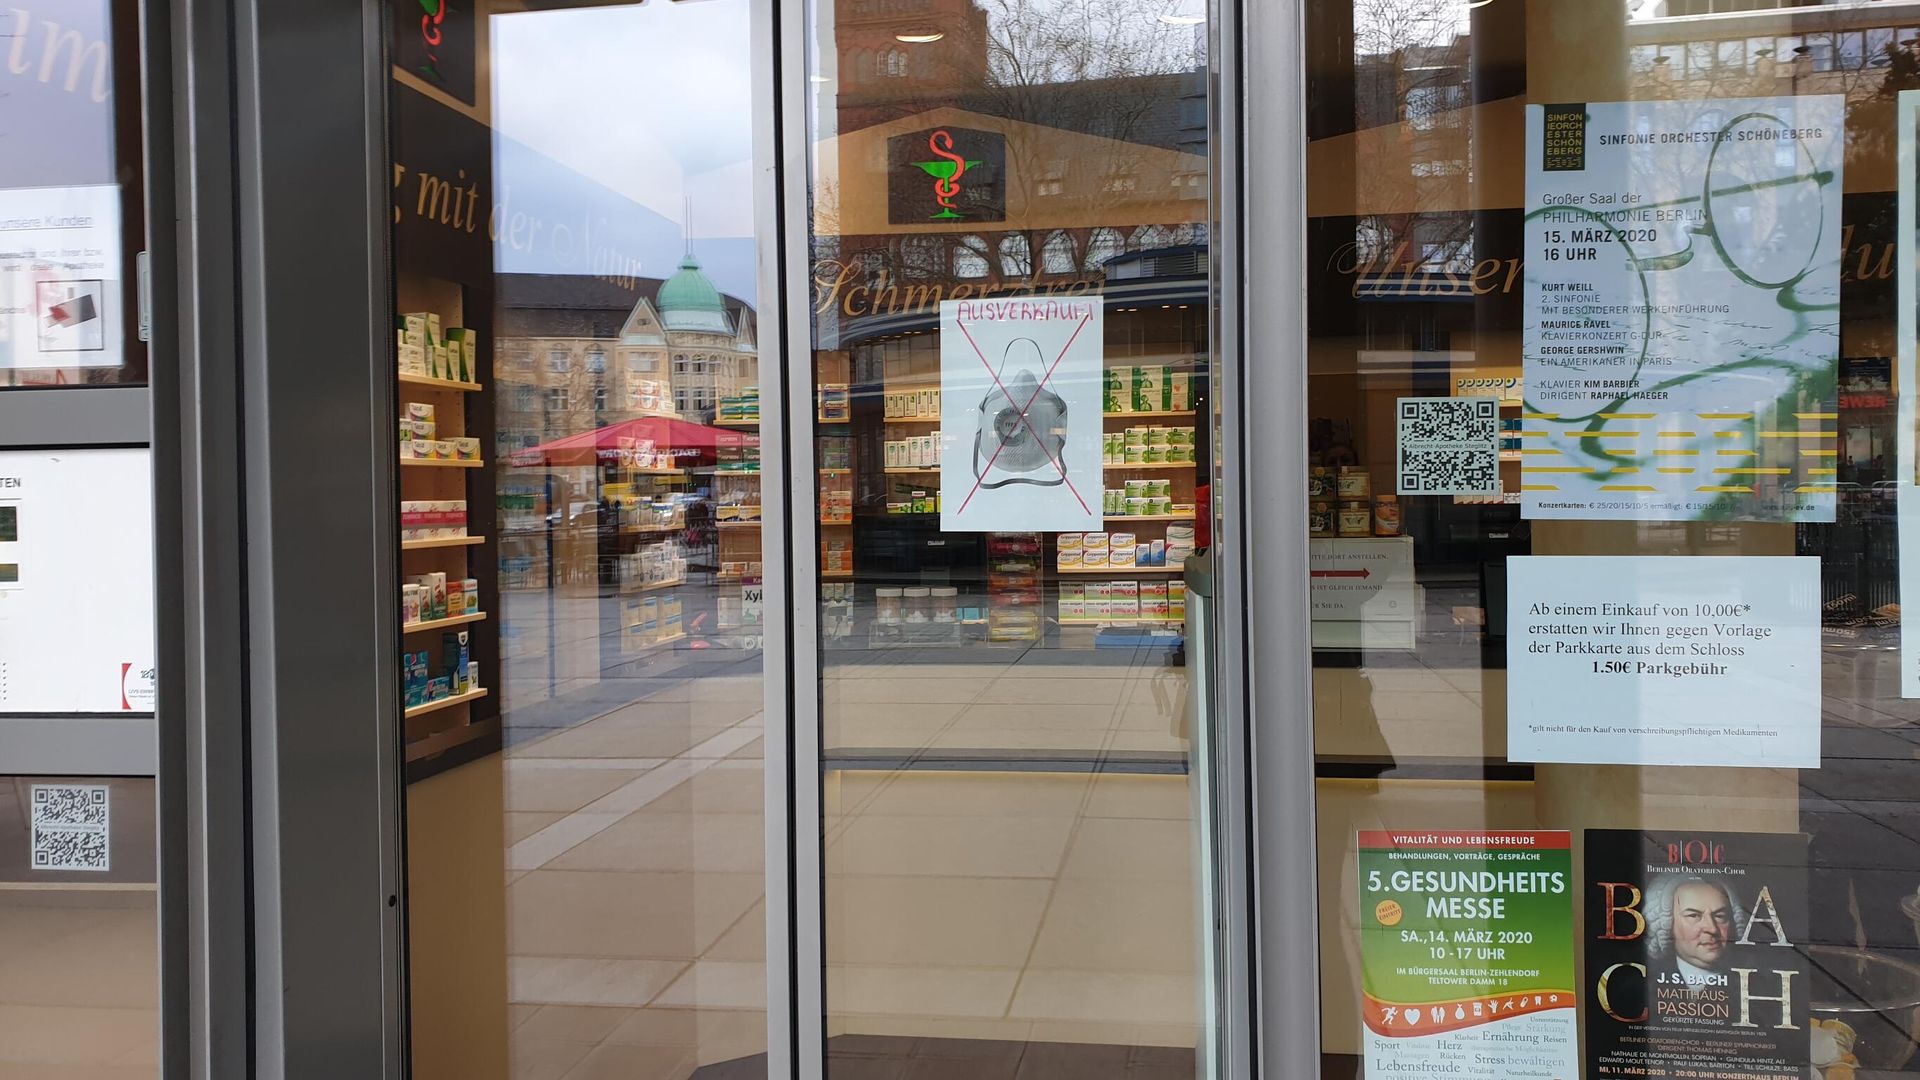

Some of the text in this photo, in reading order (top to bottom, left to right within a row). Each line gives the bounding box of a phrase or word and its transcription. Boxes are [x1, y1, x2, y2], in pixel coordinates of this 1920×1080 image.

[1547, 113, 1583, 121] SINFON
[1547, 122, 1582, 130] IEORCH
[1546, 130, 1582, 138] ESTER
[1600, 126, 1822, 146] SINFONIE ORCHESTER SCHÖNEBERG
[1546, 147, 1582, 155] EBERG
[1543, 192, 1642, 205] Großer Saal der
[416, 169, 478, 233] mit
[489, 184, 542, 252] der
[1543, 208, 1707, 223] PHILHARMONIE BERLIN
[44, 215, 92, 227] Kunden
[1544, 228, 1657, 243] 15. MÄRZ 2020
[1544, 248, 1597, 261] 16 UHR
[1326, 241, 1525, 299] Unser
[1541, 283, 1594, 292] KURT WEILL
[1541, 294, 1601, 303] 2. SINFONIE
[1541, 303, 1729, 315] MIT BESONDERER WERKEINFÜHRUNG
[1541, 320, 1611, 329] MAURICE RAVEL
[1541, 331, 1662, 341] KLAVIERKONZERT G-DUR
[1540, 346, 1624, 355] GEORGE GERSHWIN
[1540, 356, 1672, 366] EIN AMERIKANER IN PARIS
[1540, 380, 1640, 389] KLAVIER KIM BARBIER
[1540, 391, 1669, 400] DIRIGENT RAPHAEL HAEGER
[1529, 603, 1550, 616] Ab
[1554, 604, 1597, 616] einem
[1602, 603, 1659, 617] Einkauf
[1662, 607, 1689, 617] von
[1528, 623, 1772, 641] erstatten wir Ihnen gegen Vorlage
[1528, 641, 1745, 656] der Parkkarte aus dem Schloss
[1592, 661, 1728, 677] 1.50€ Parkgebühr
[1546, 725, 1564, 733] nicht
[1566, 725, 1578, 733] für
[1580, 725, 1591, 733] den
[1593, 725, 1610, 733] Kauf
[1628, 726, 1721, 737] verschreibungspflichtigen
[1722, 728, 1778, 737] Medikamenten
[1393, 835, 1535, 845] VITALITÄT UND LEBENSFREUDE
[1388, 852, 1541, 861] BEHANDLUNGEN, VORTRÄGE, GESPRÄCHE
[1426, 897, 1505, 919] MESSE
[1597, 882, 1794, 947] B A
[1454, 929, 1493, 944] MÄRZ
[1495, 932, 1533, 944] 2020
[1430, 947, 1505, 960] 10 17 UHR
[1396, 967, 1540, 977] IM BÜRGERSAAL BERLIN-ZEHLENDORF
[1428, 977, 1507, 986] TELTOWER DAMM 18
[1657, 973, 1728, 987] J. S. BACH
[1597, 963, 1801, 1030] C H
[1657, 987, 1729, 1002] MATTHÄUS-
[1657, 1001, 1729, 1018] PASSION
[1662, 1016, 1724, 1026] GEKÜRZTE FASSUNG
[1526, 1023, 1566, 1034] Stärkung
[1482, 1031, 1567, 1045] Ernährung Reisen
[1374, 1040, 1400, 1051] Sport
[1437, 1040, 1462, 1052] Herz
[1439, 1052, 1565, 1068] Rücken Stress bewältigen
[1376, 1059, 1553, 1077] Lebensfreude Vitalität Naturheilkunde
[1624, 1067, 1646, 1075] MÄRZ
[1716, 1072, 1770, 1080] KONZERTHAUS
